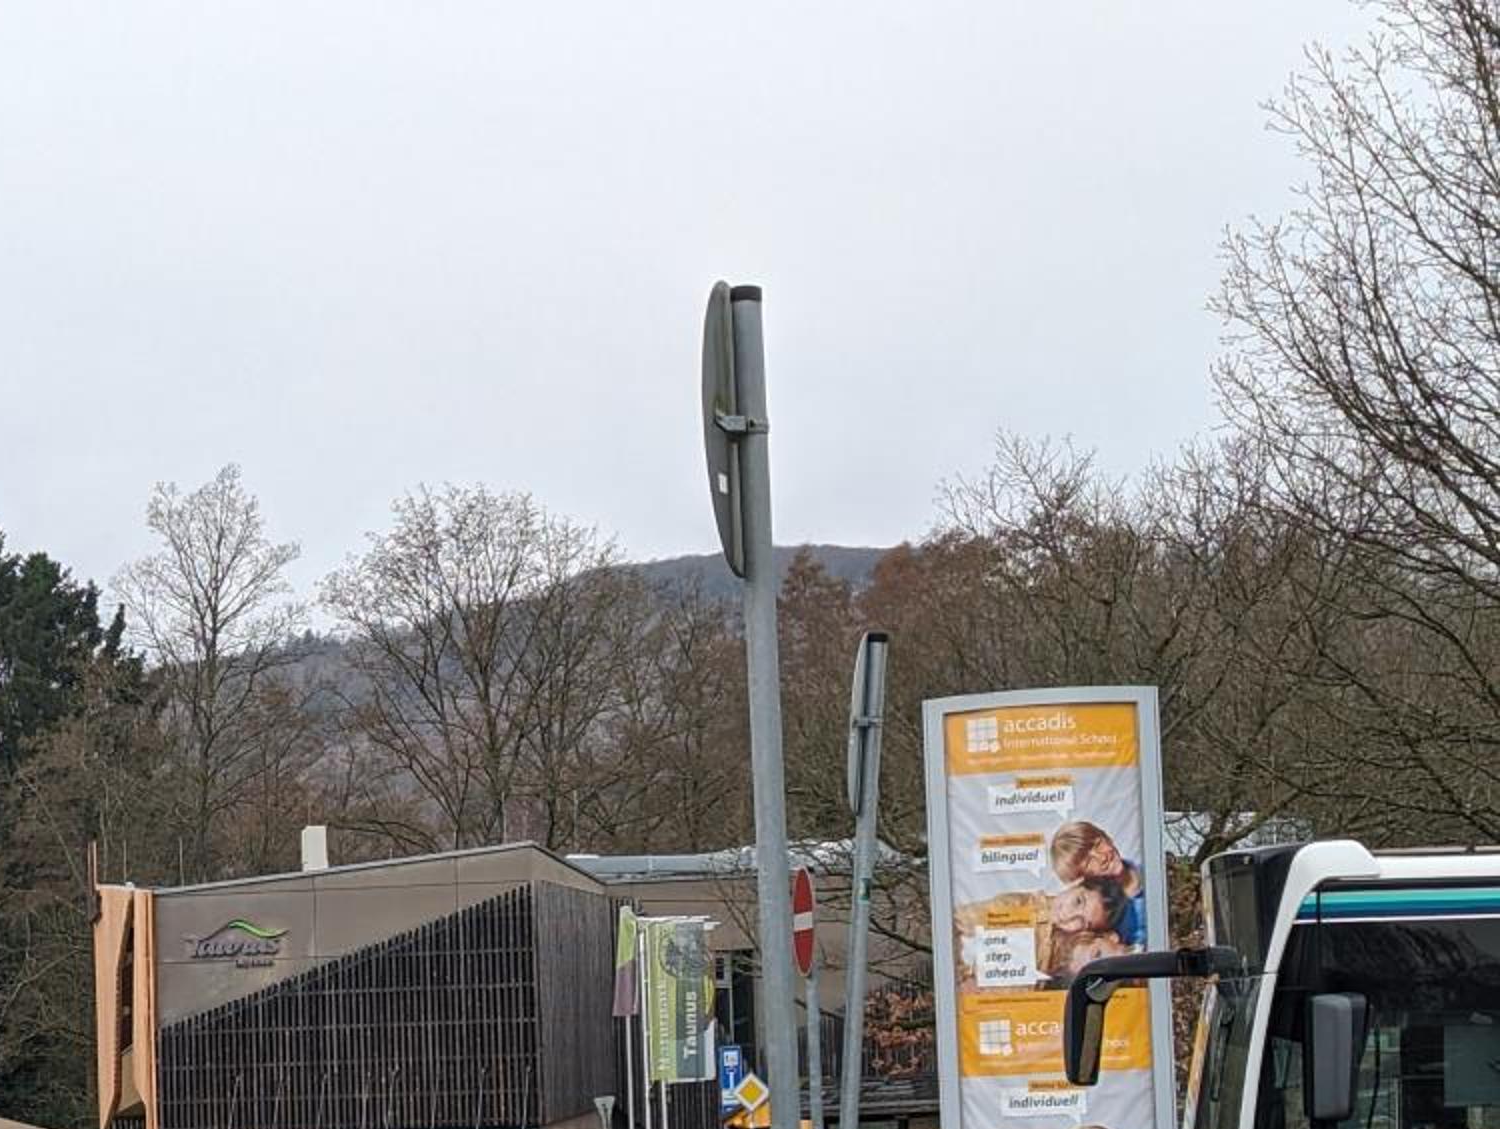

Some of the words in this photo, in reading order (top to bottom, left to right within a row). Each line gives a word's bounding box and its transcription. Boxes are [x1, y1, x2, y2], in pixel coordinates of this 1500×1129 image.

[1003, 712, 1077, 733] accadis
[995, 791, 1066, 806] individuell
[981, 849, 1039, 865] bilingual
[984, 936, 1007, 946] one
[985, 951, 1012, 963] step
[985, 966, 1027, 979] ahead
[683, 991, 697, 1059] Taunus
[1015, 1020, 1063, 1037] acca
[1008, 1095, 1079, 1109] individuell
